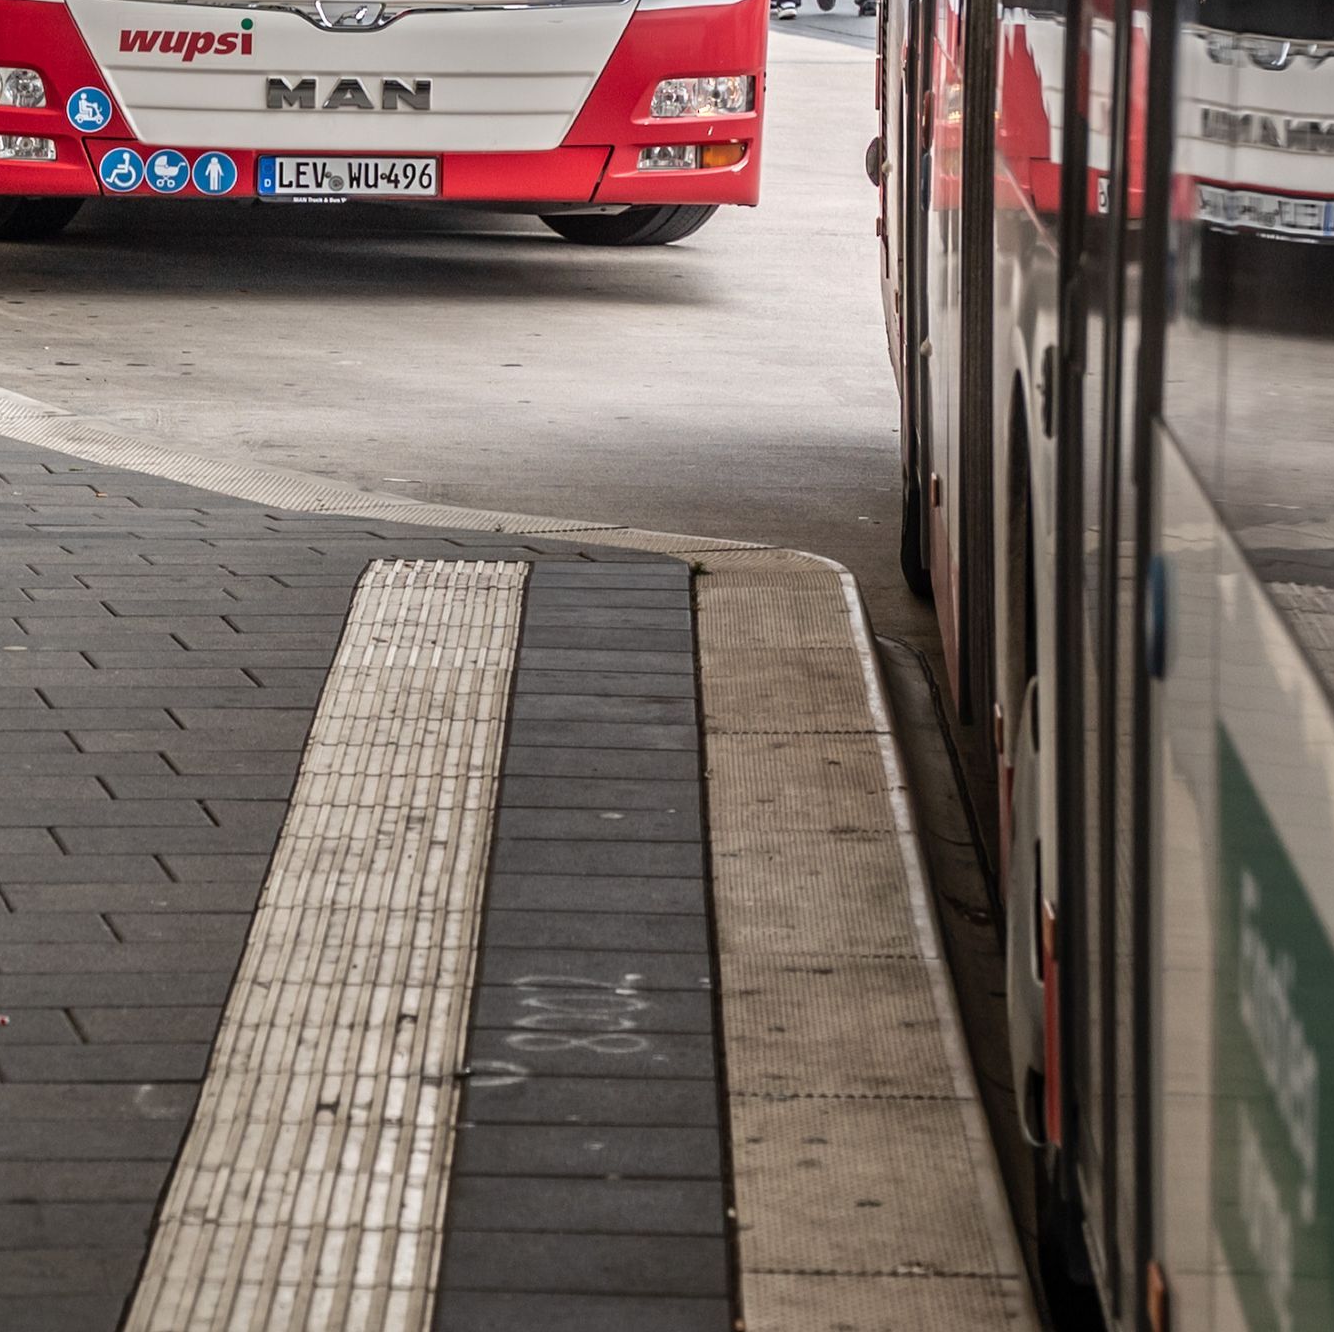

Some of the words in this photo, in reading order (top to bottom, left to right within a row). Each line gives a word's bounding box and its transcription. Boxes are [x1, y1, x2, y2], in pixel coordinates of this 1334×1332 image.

[119, 18, 254, 62] wupsi
[266, 77, 433, 111] MAN
[264, 179, 272, 188] D
[279, 162, 327, 189] LEV
[348, 162, 379, 189] WU
[387, 163, 432, 190] 496
